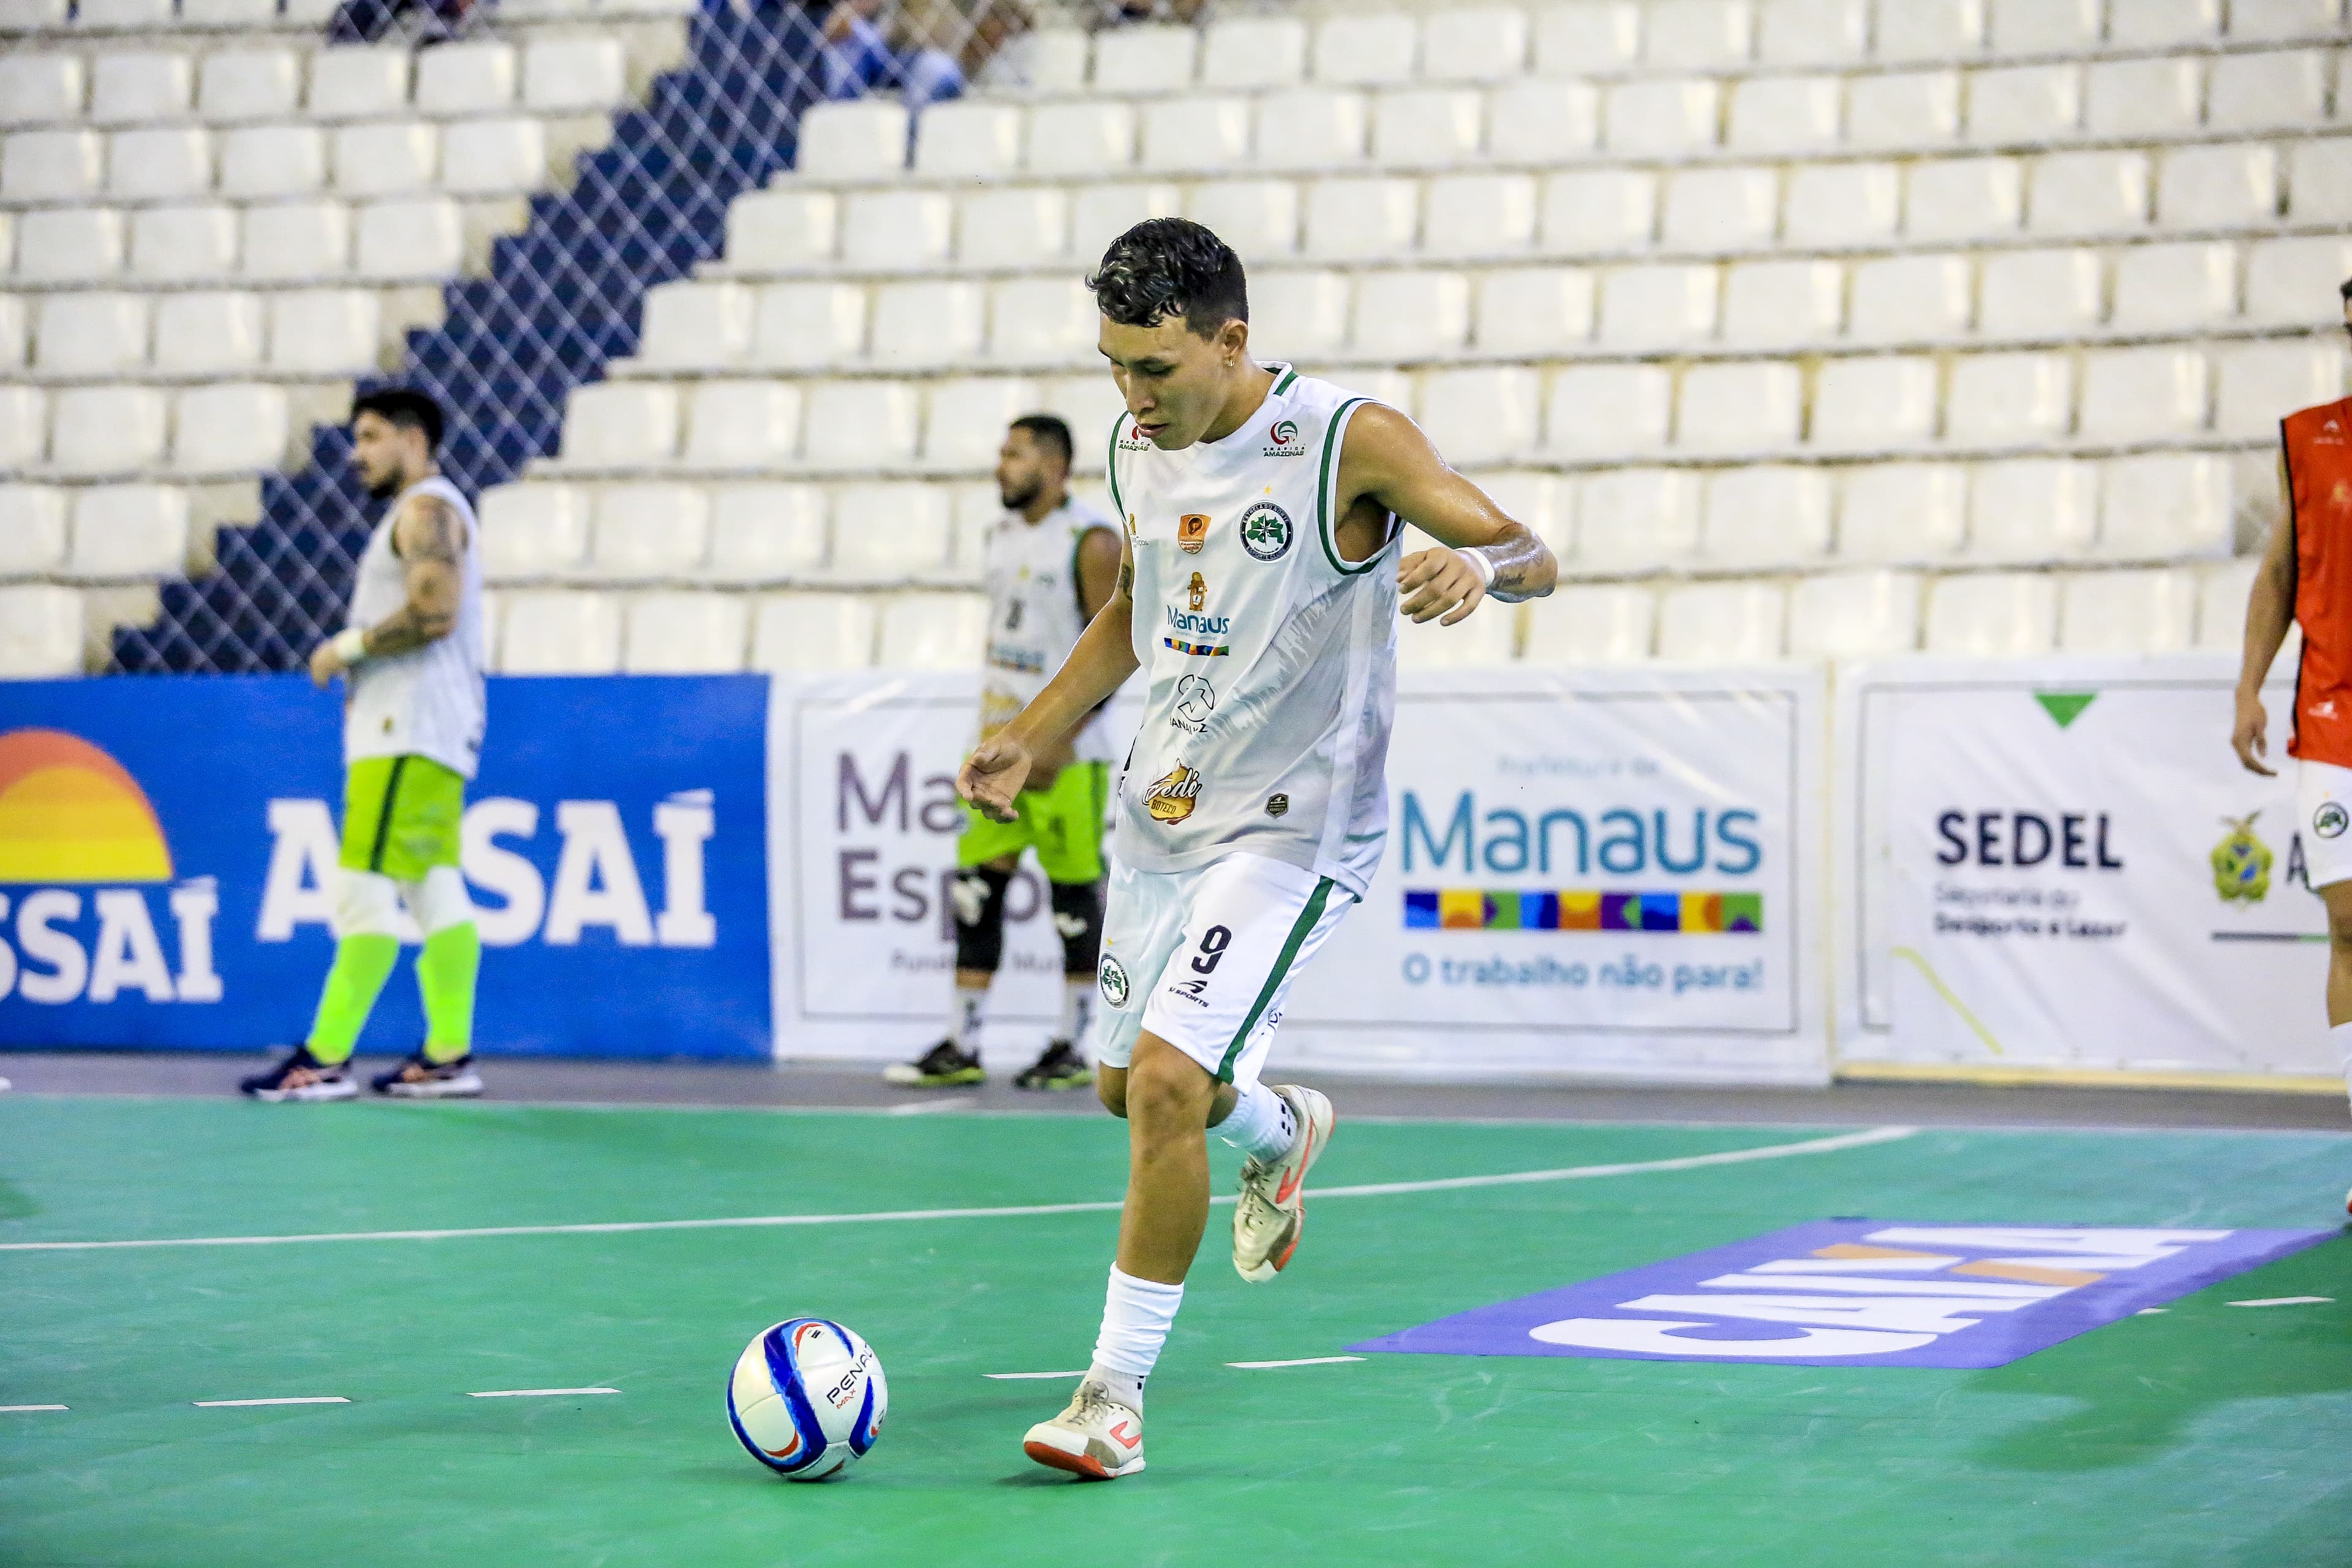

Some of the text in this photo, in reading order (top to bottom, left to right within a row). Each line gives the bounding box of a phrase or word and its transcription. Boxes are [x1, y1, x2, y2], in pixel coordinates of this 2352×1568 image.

[1167, 605, 1230, 635] Manaus
[1151, 799, 1177, 815] BOTECO
[1400, 789, 1763, 875] Manaus
[1936, 811, 2124, 870] SEDEL
[255, 788, 717, 948] ASAÍ
[1191, 924, 1232, 974] 9
[1401, 953, 1431, 984] O
[1439, 952, 1589, 986] trabalho
[1598, 952, 1665, 986] não
[1175, 989, 1210, 1008] SPORTS
[1529, 1227, 2234, 1357] CAIXA
[826, 1340, 873, 1404] PENAL
